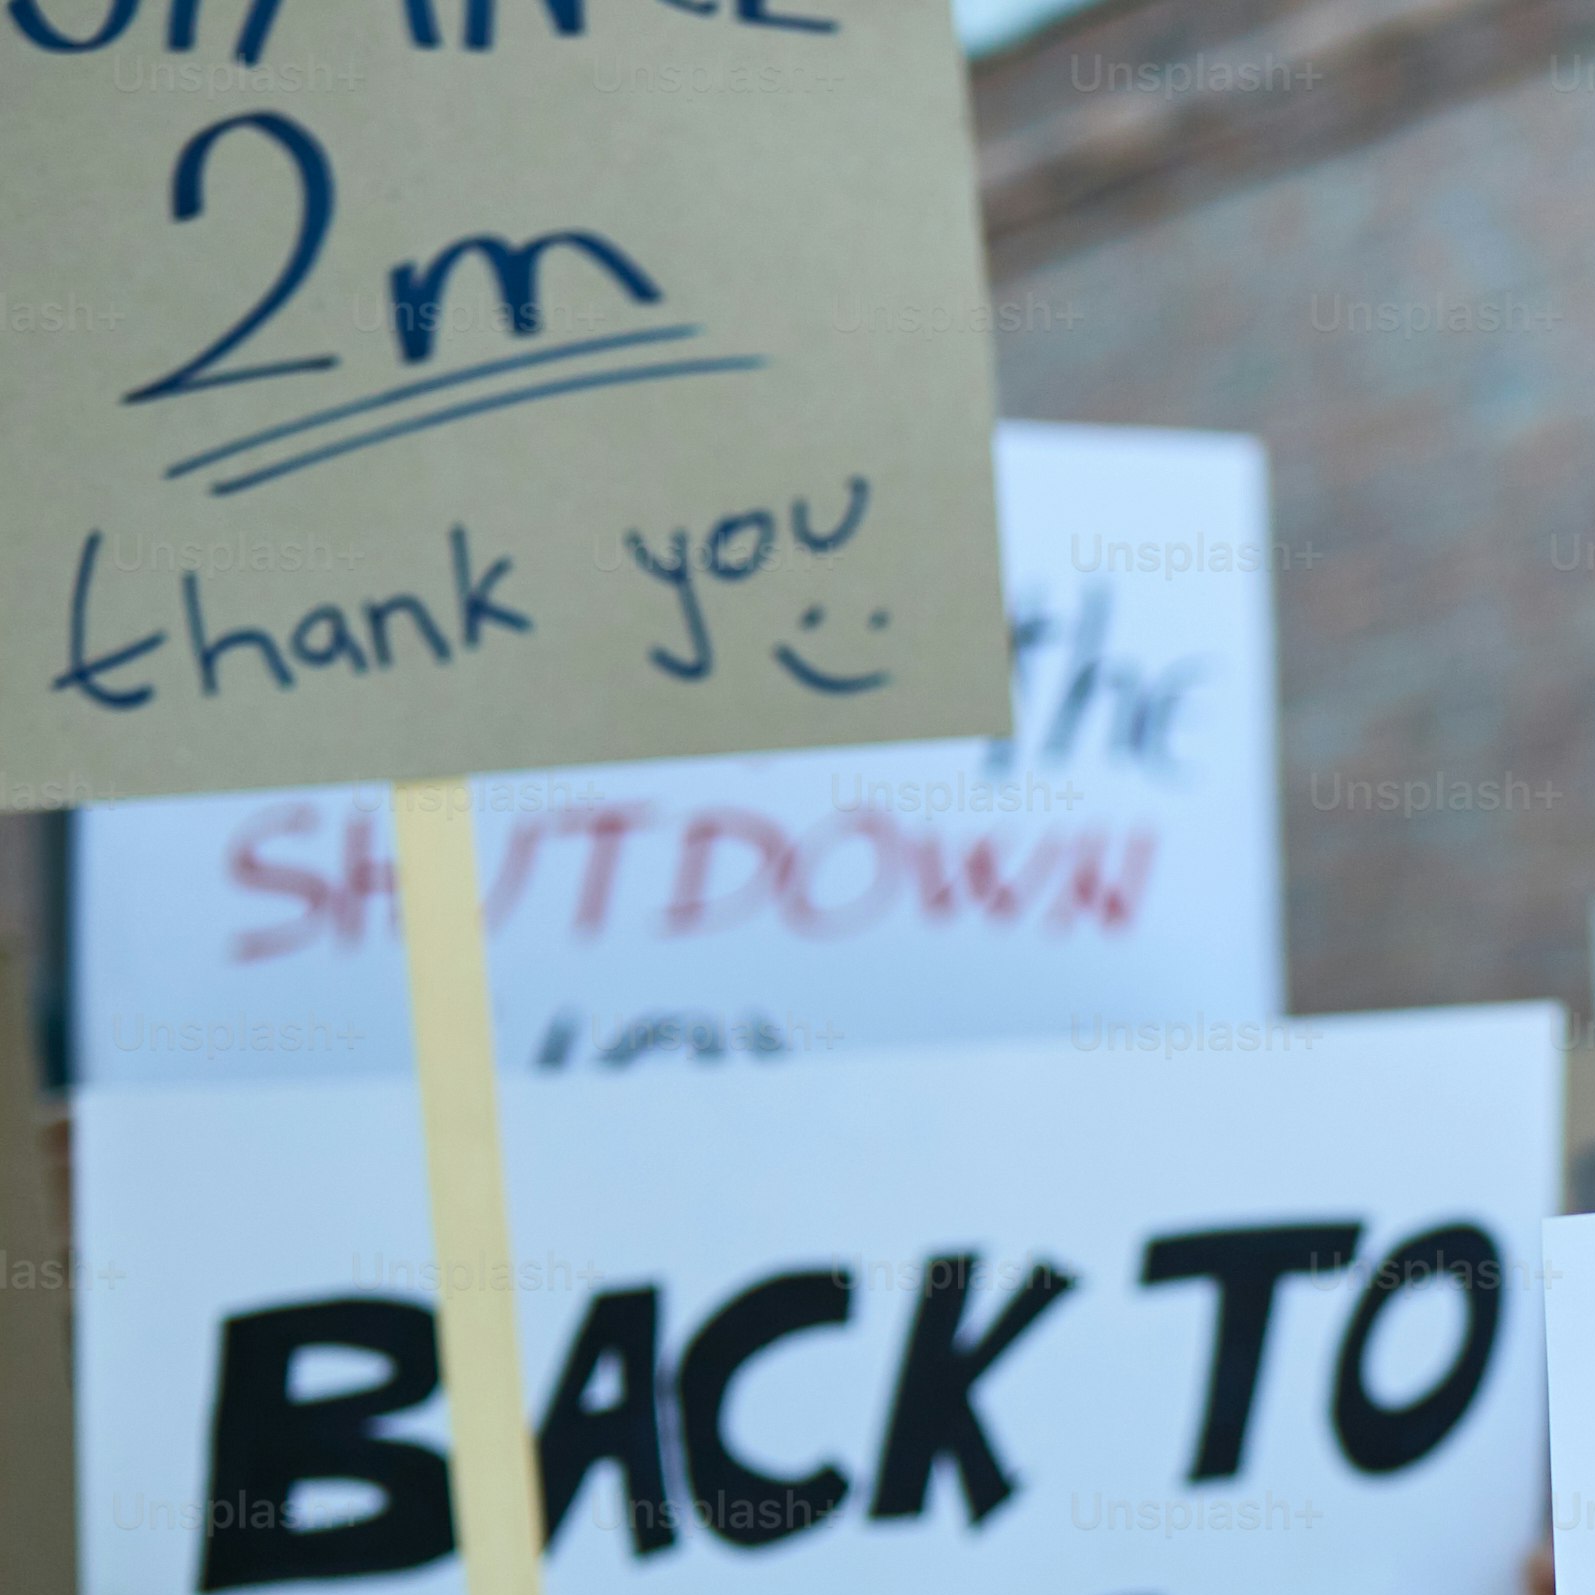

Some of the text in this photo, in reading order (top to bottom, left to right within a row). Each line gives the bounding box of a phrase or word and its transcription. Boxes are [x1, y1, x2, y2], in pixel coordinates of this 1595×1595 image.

[122, 110, 662, 405] 2m
[50, 477, 870, 712] thank you
[1140, 1220, 1506, 1484] TO
